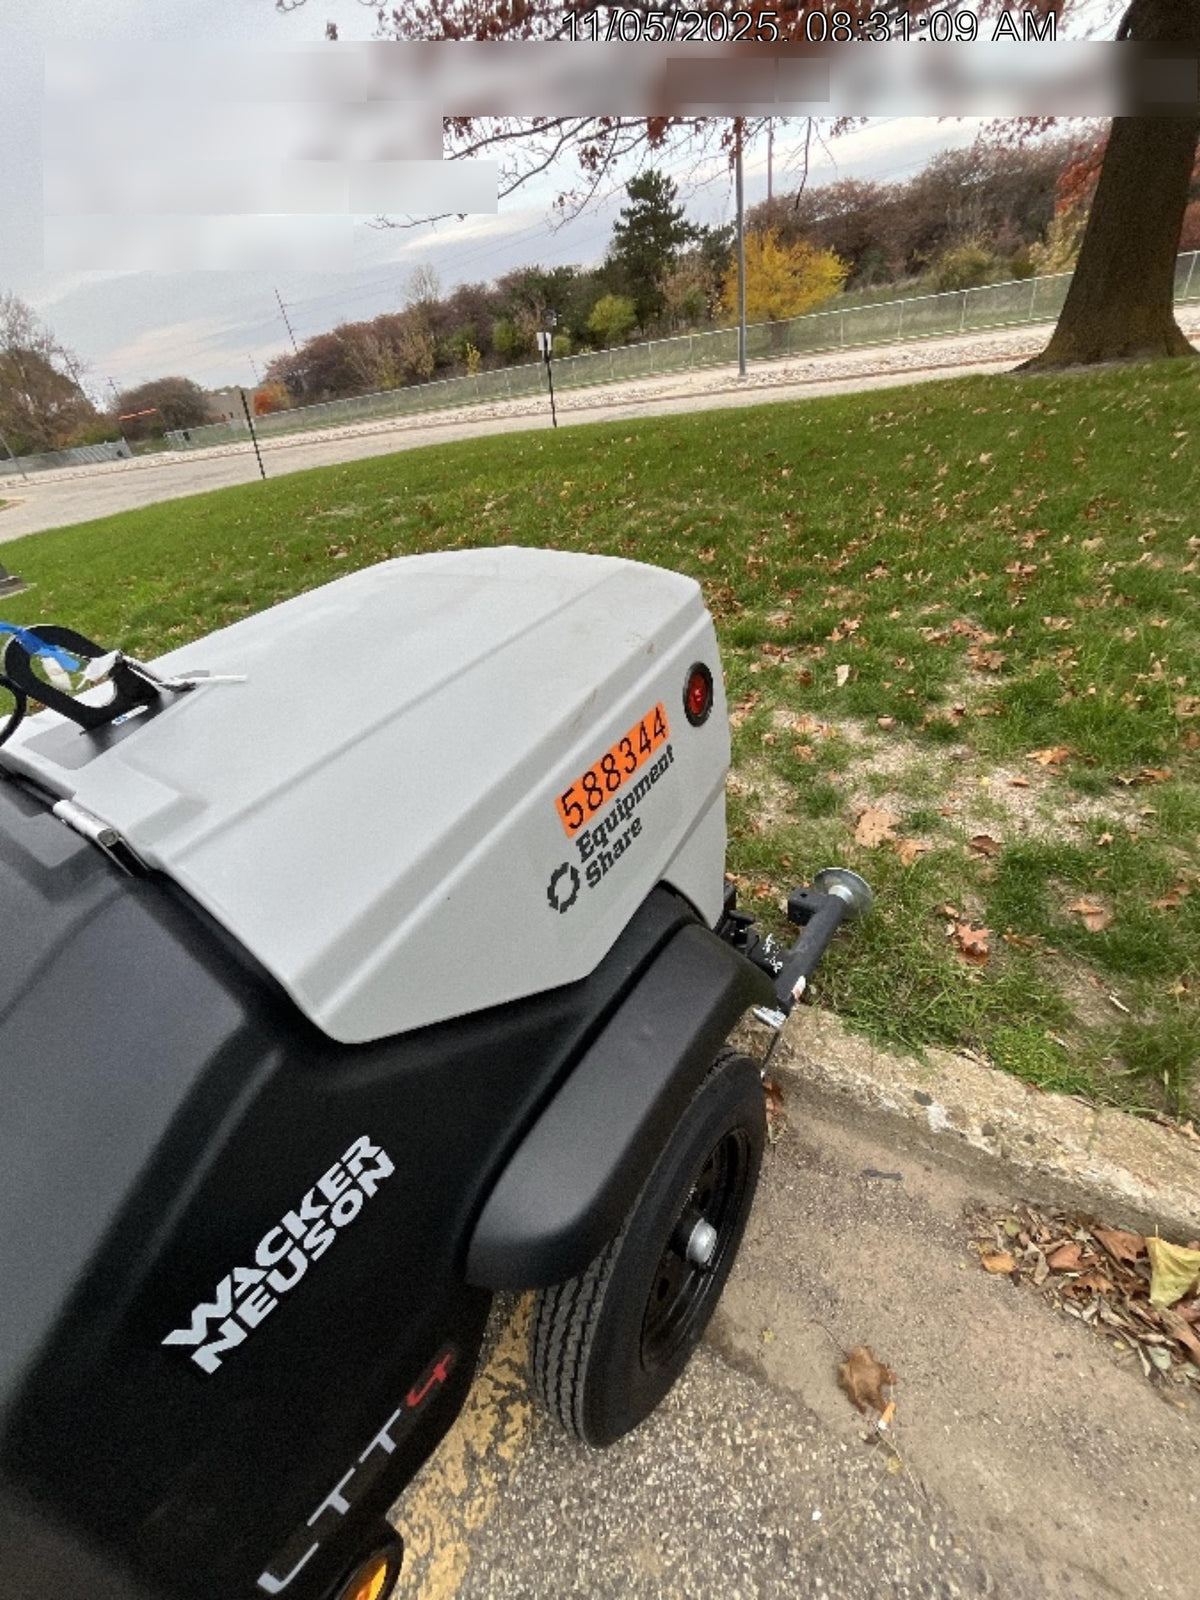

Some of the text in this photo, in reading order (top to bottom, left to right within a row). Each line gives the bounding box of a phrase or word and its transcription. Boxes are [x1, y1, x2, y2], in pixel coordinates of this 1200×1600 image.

[560, 707, 666, 830] 588344
[575, 744, 675, 863] Equipment
[584, 817, 642, 889] Share
[161, 1135, 382, 1345] WACKER
[190, 1149, 396, 1375] NEUSON
